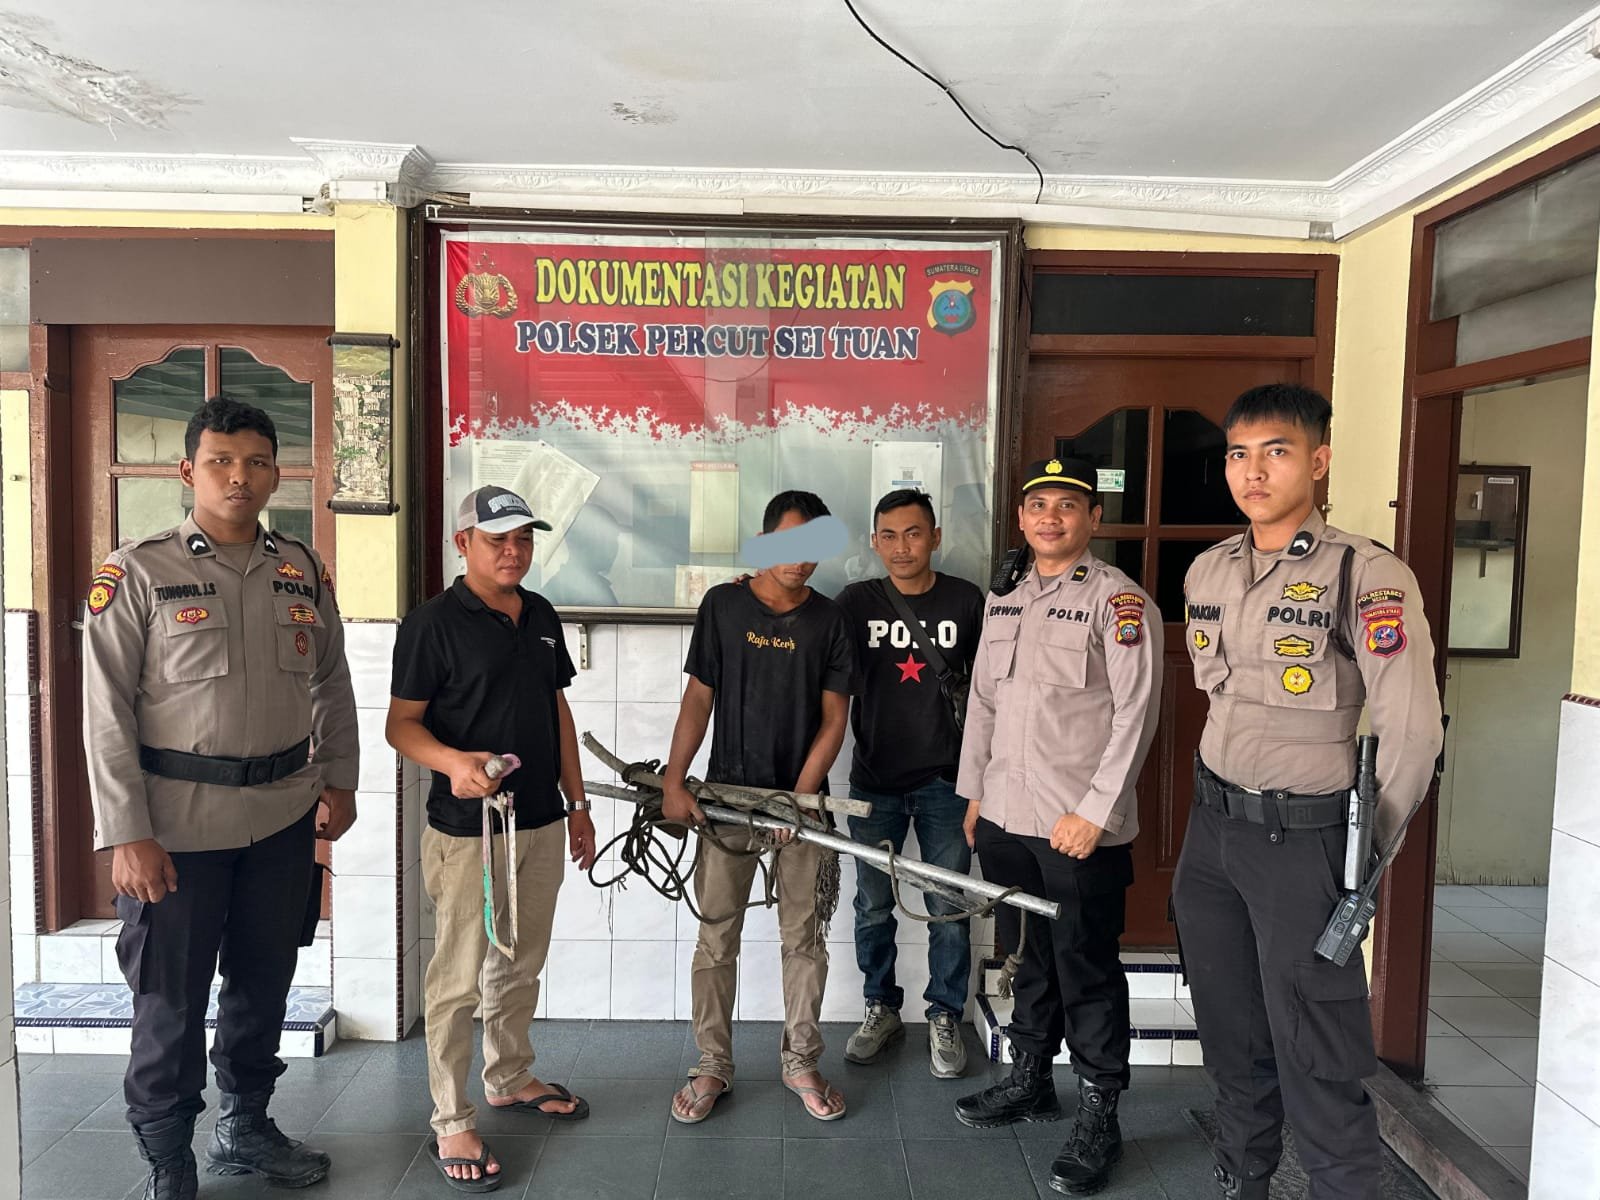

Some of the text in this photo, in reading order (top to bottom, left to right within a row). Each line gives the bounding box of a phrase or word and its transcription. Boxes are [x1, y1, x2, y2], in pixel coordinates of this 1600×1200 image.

[926, 264, 958, 276] SUMATERA
[535, 257, 907, 310] DOKUMENTASI KEGIATAN
[514, 320, 921, 361] POLSEK PERCUT SEI TUAN
[272, 580, 314, 600] POLRI
[989, 605, 1024, 618] ERWIN
[1047, 607, 1090, 624] POLRI
[1267, 606, 1331, 629] POLRI
